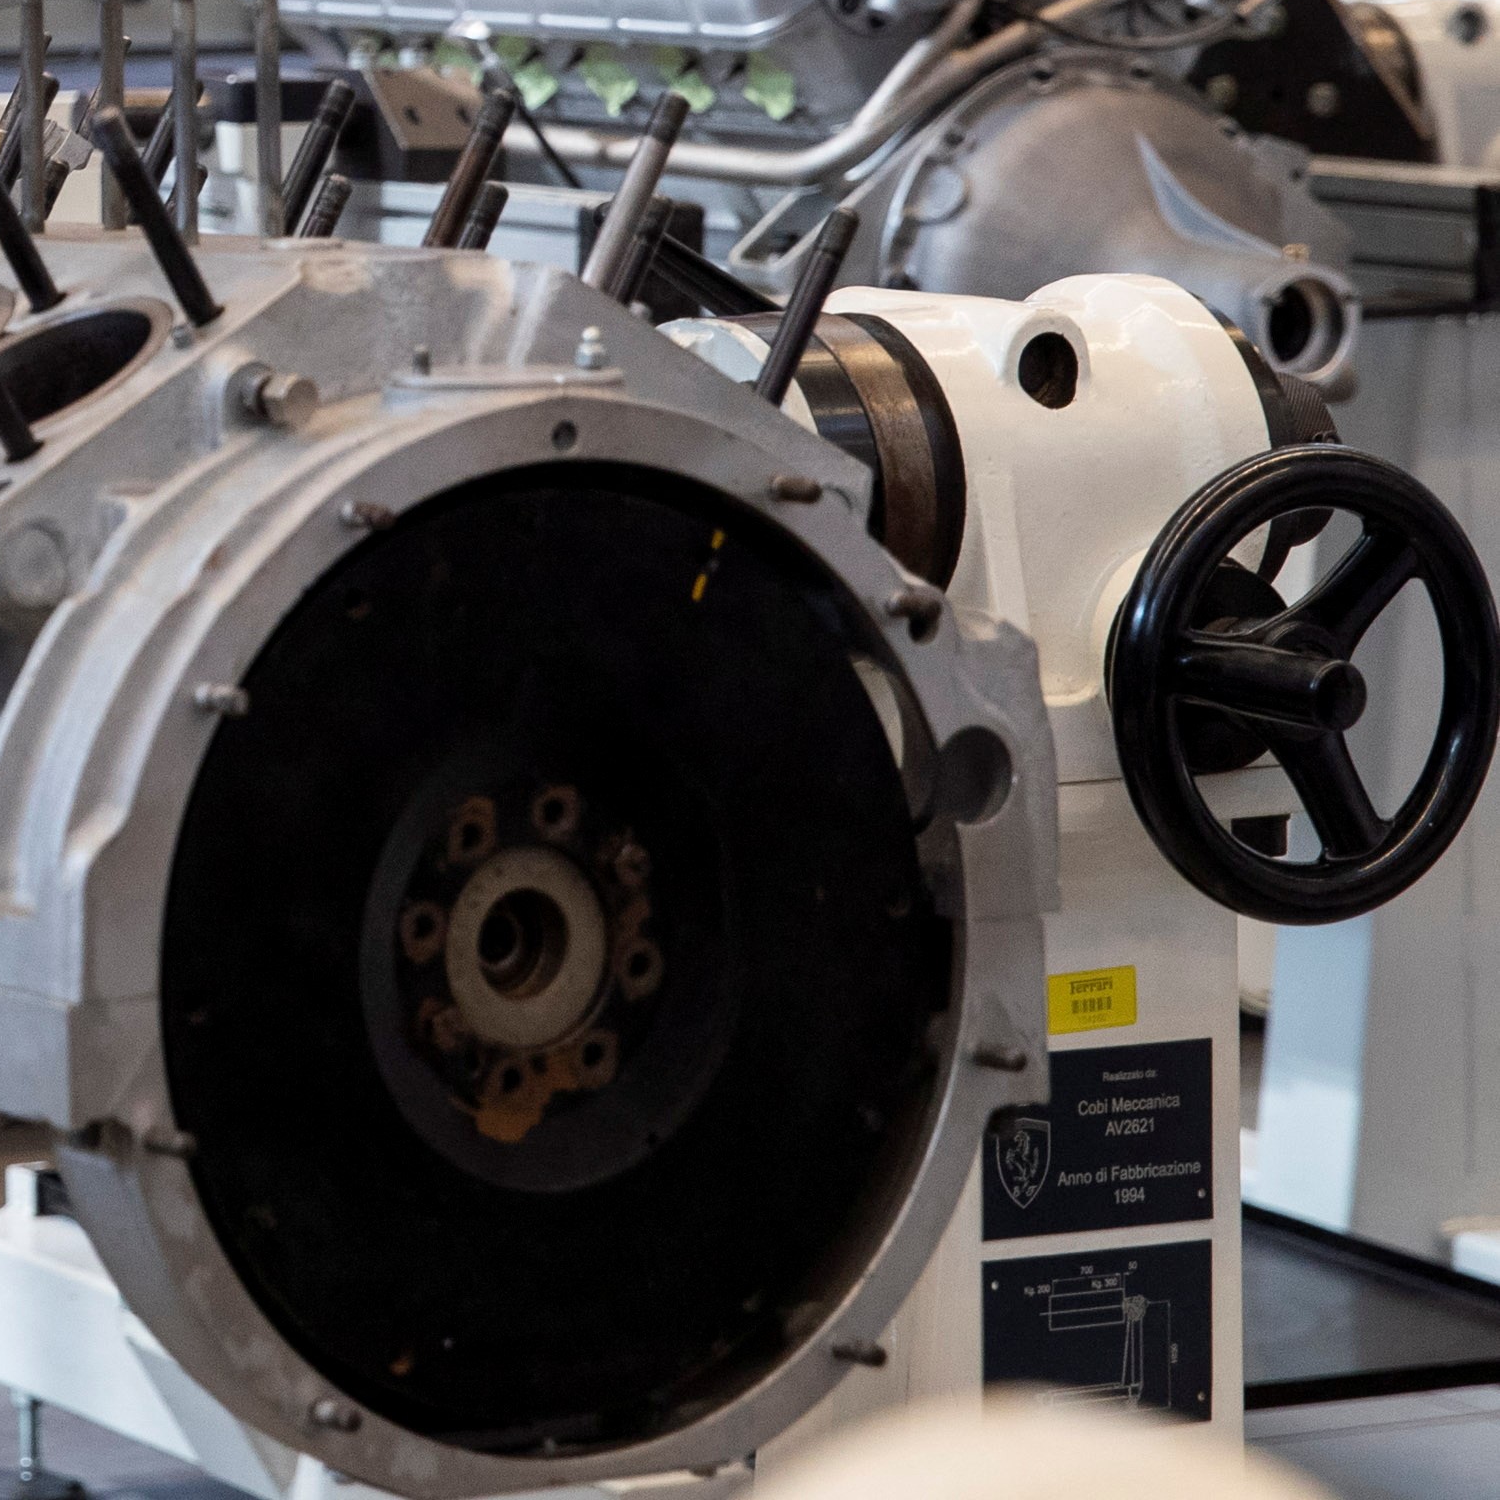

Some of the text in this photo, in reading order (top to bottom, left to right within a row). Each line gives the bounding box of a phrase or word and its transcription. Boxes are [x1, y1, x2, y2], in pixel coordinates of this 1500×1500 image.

[1070, 977, 1113, 994] Ferrari
[1078, 1094, 1180, 1116] Cobi Meccanica
[1105, 1118, 1155, 1137] AV2621
[1057, 1160, 1201, 1187] Anno di Fabbricazione
[1113, 1186, 1145, 1204] 1994
